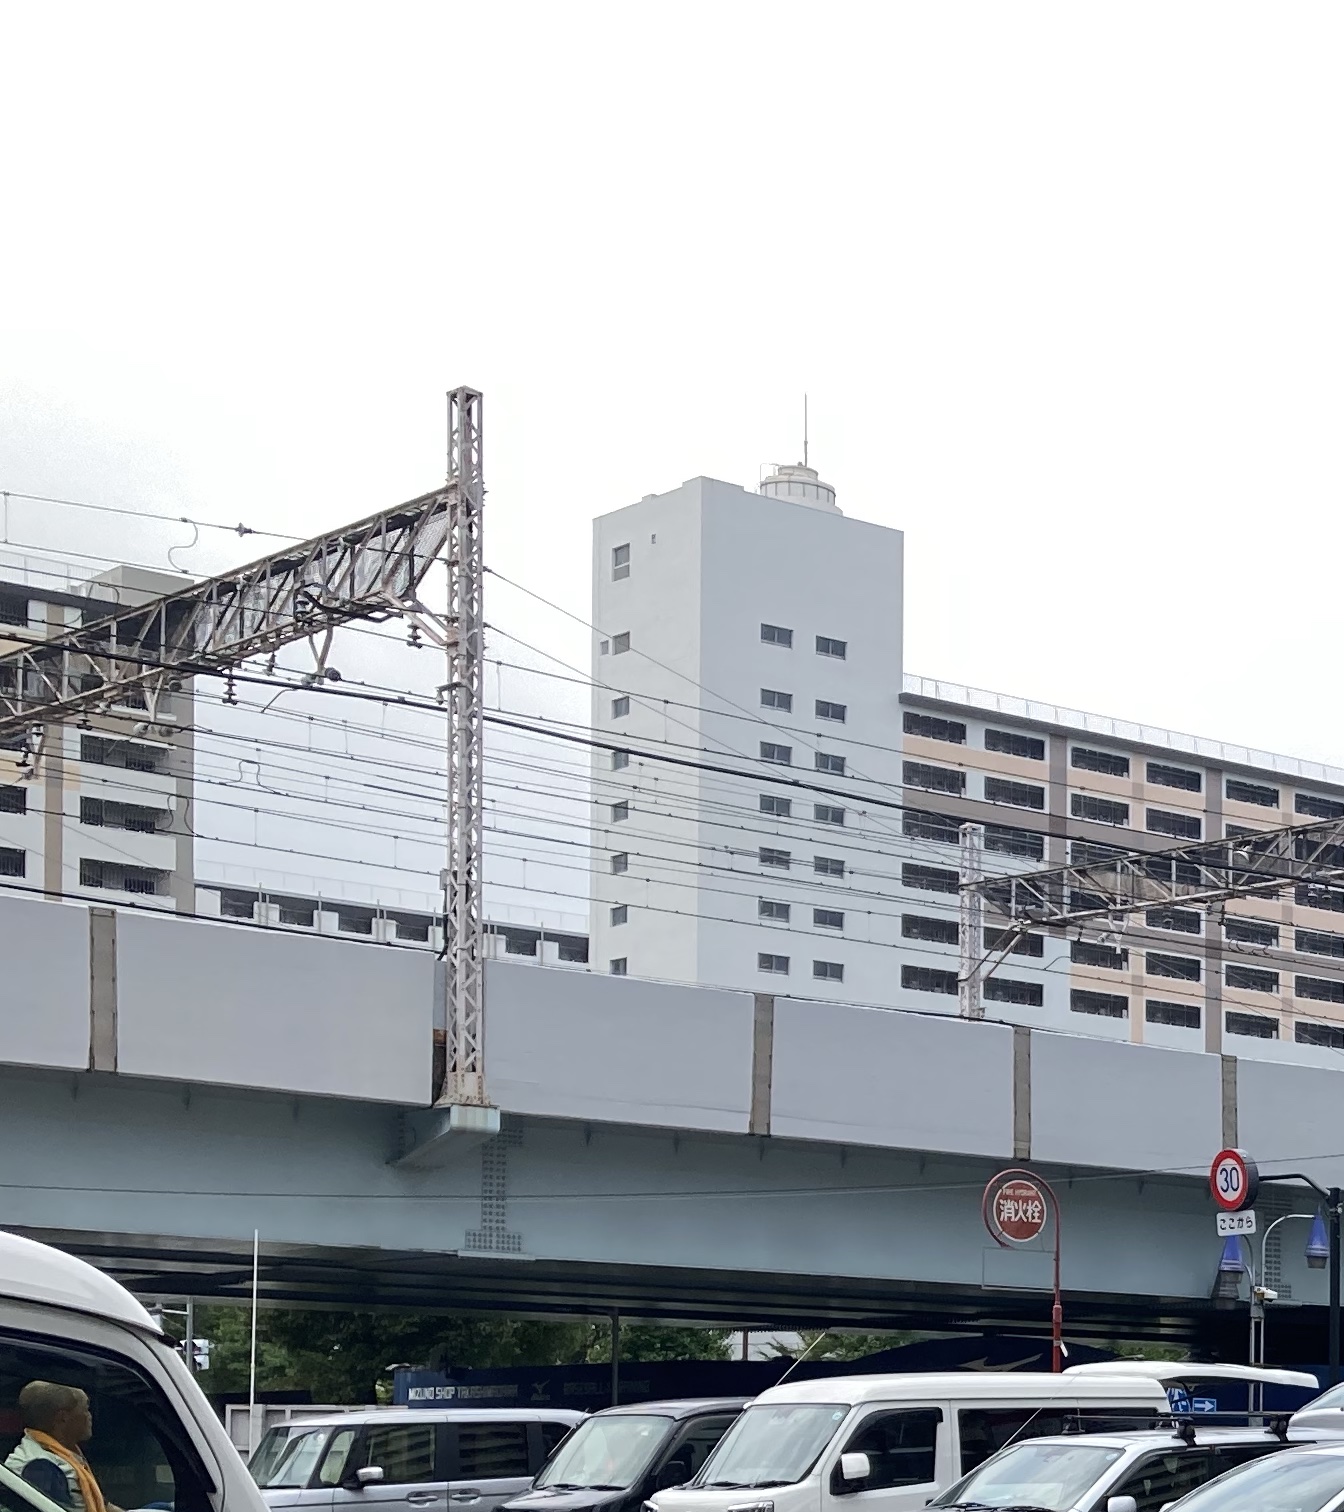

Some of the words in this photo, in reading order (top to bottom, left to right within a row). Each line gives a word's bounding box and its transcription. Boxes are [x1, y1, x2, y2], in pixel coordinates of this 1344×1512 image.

[1220, 1167, 1239, 1192] 30
[1000, 1199, 1042, 1222] 消火栓
[1220, 1216, 1253, 1230] ここから
[435, 1386, 456, 1400] SHOP
